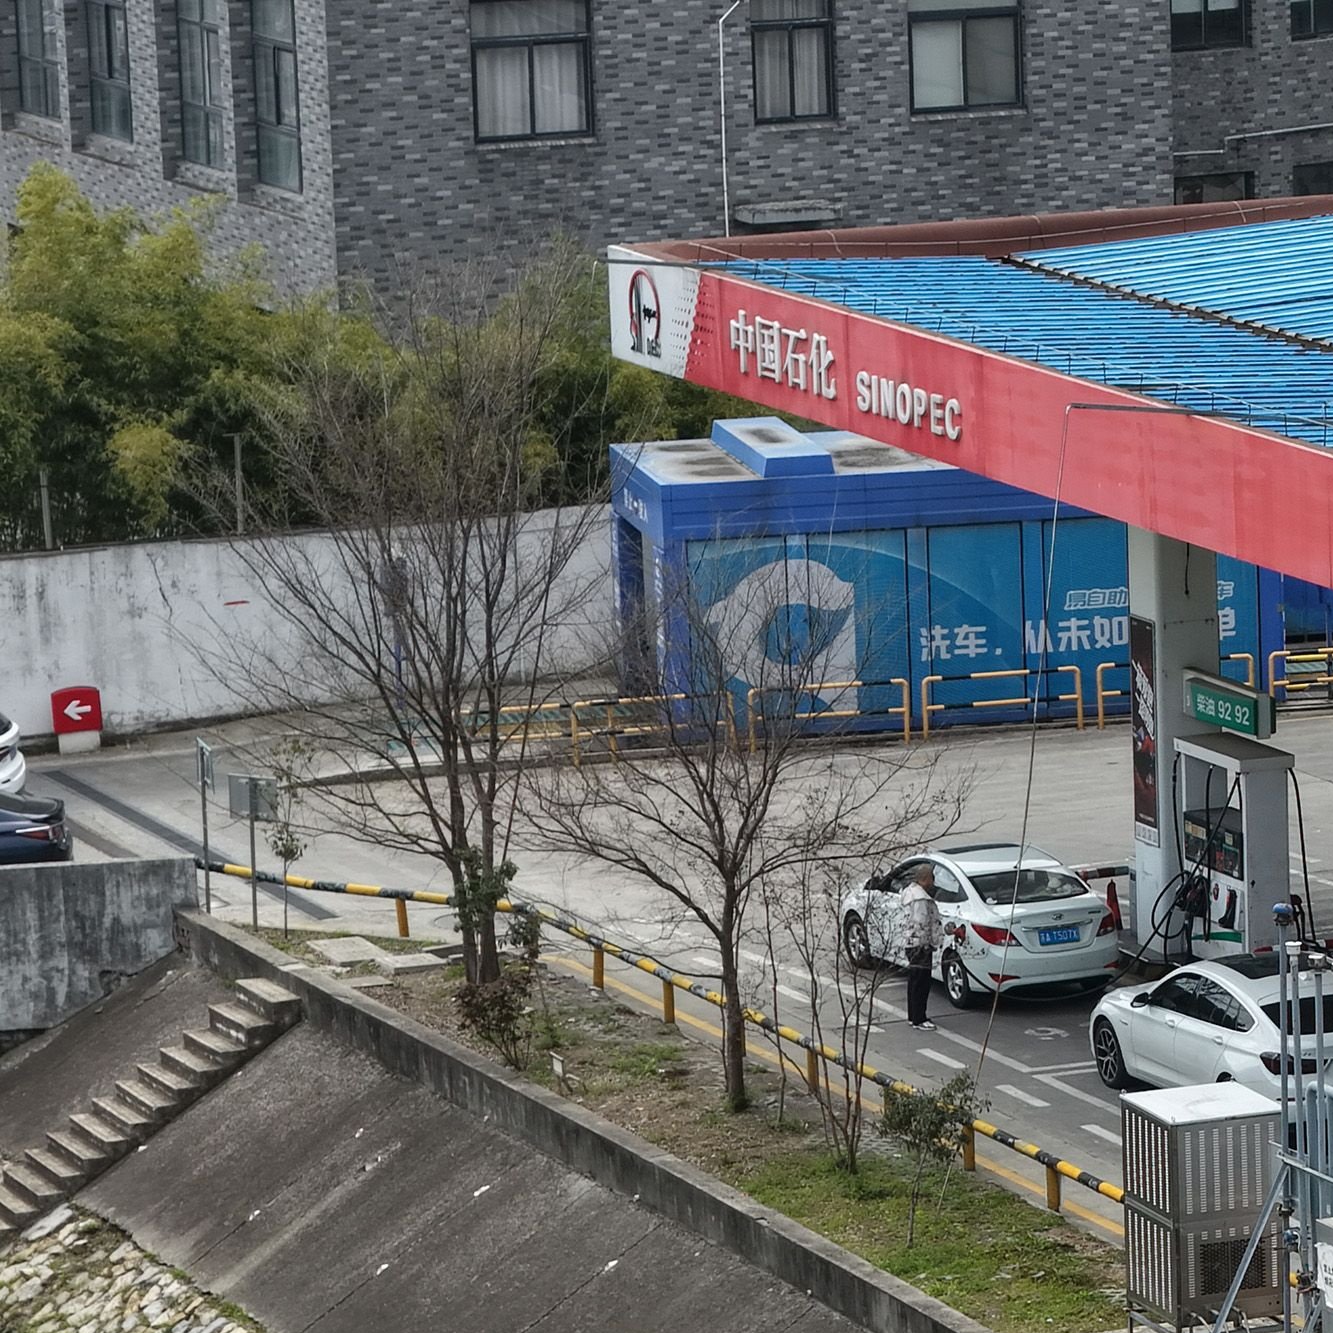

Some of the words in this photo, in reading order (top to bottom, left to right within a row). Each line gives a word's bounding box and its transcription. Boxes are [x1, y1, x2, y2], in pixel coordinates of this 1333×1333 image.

[730, 308, 838, 401] 中国石化
[856, 370, 963, 442] SINOPEC
[1217, 700, 1232, 721] 92
[1234, 704, 1250, 726] 92
